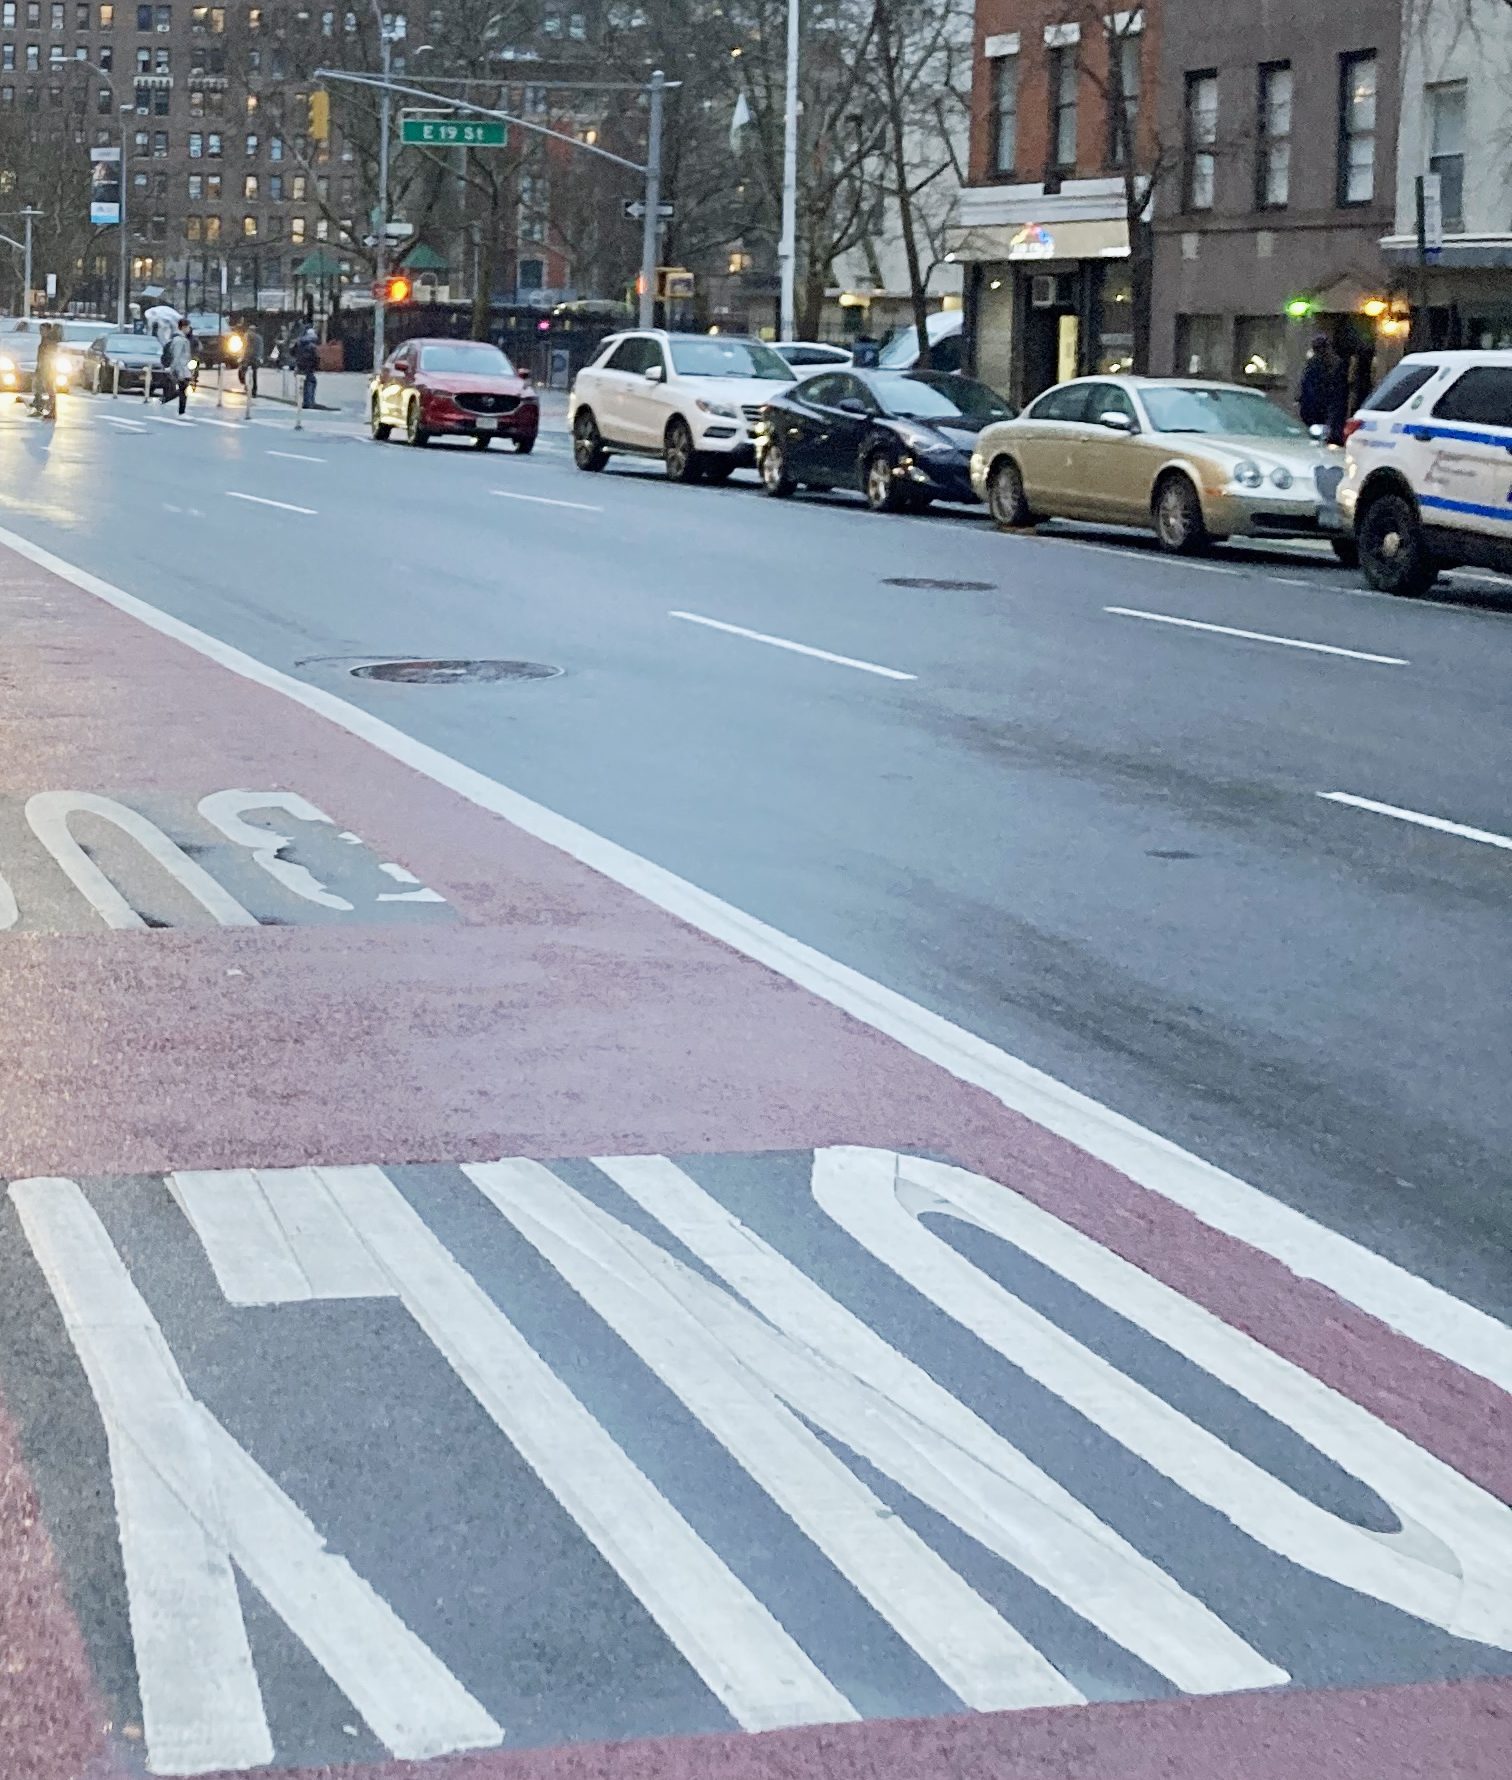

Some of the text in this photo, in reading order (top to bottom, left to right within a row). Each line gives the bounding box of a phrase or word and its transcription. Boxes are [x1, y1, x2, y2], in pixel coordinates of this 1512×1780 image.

[423, 125, 484, 140] E 19 St
[8, 1145, 1512, 1776] ONLY
